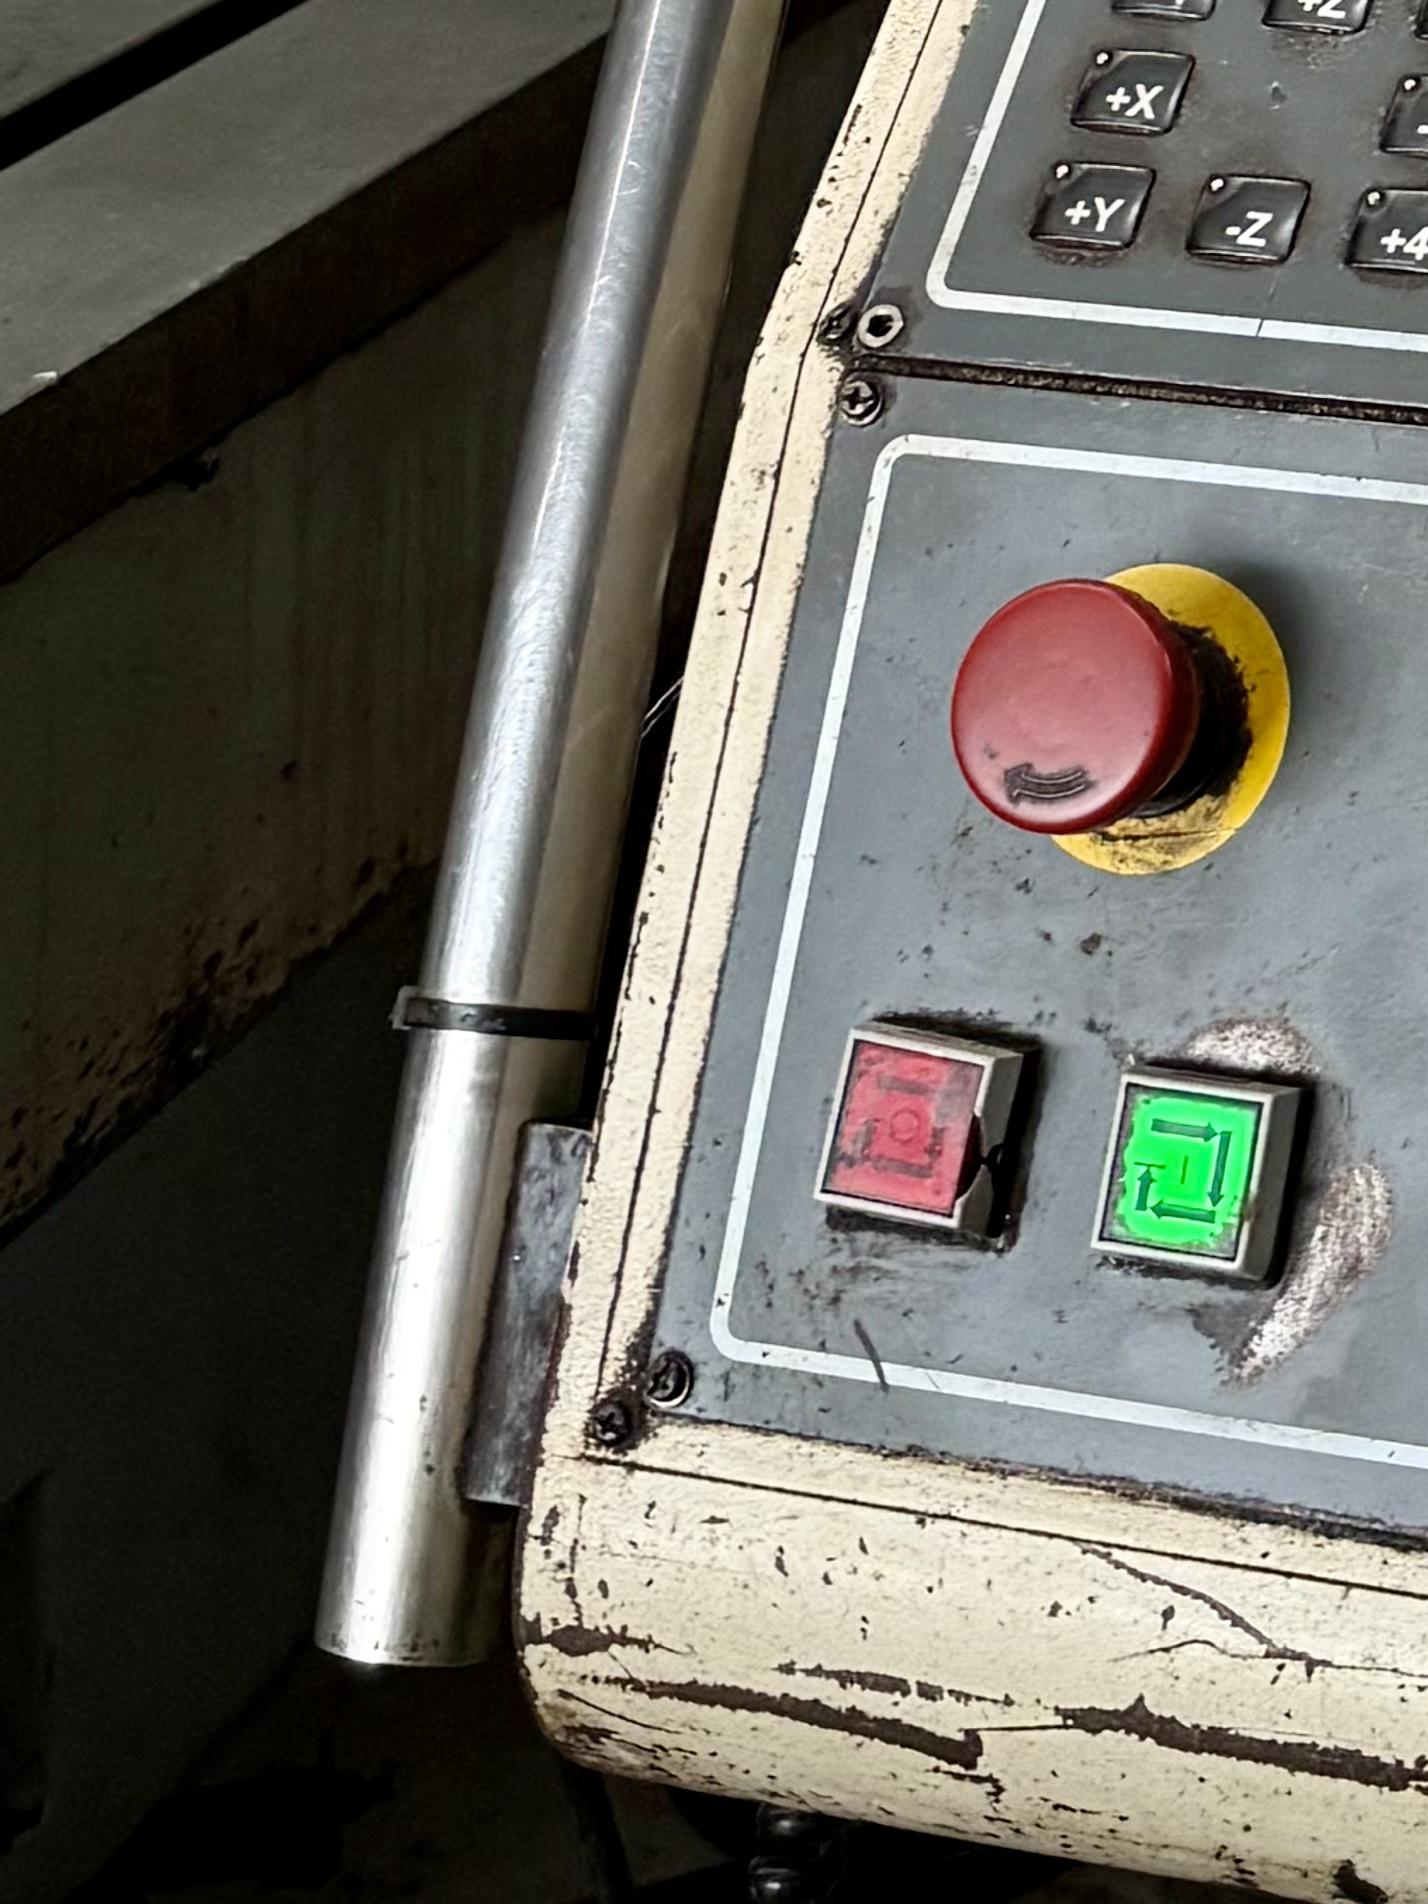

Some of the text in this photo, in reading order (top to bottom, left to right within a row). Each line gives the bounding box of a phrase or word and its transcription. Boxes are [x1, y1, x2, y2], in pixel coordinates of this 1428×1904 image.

[1105, 83, 1163, 119] +X
[1065, 196, 1125, 232] +Y
[1225, 211, 1273, 247] -Z
